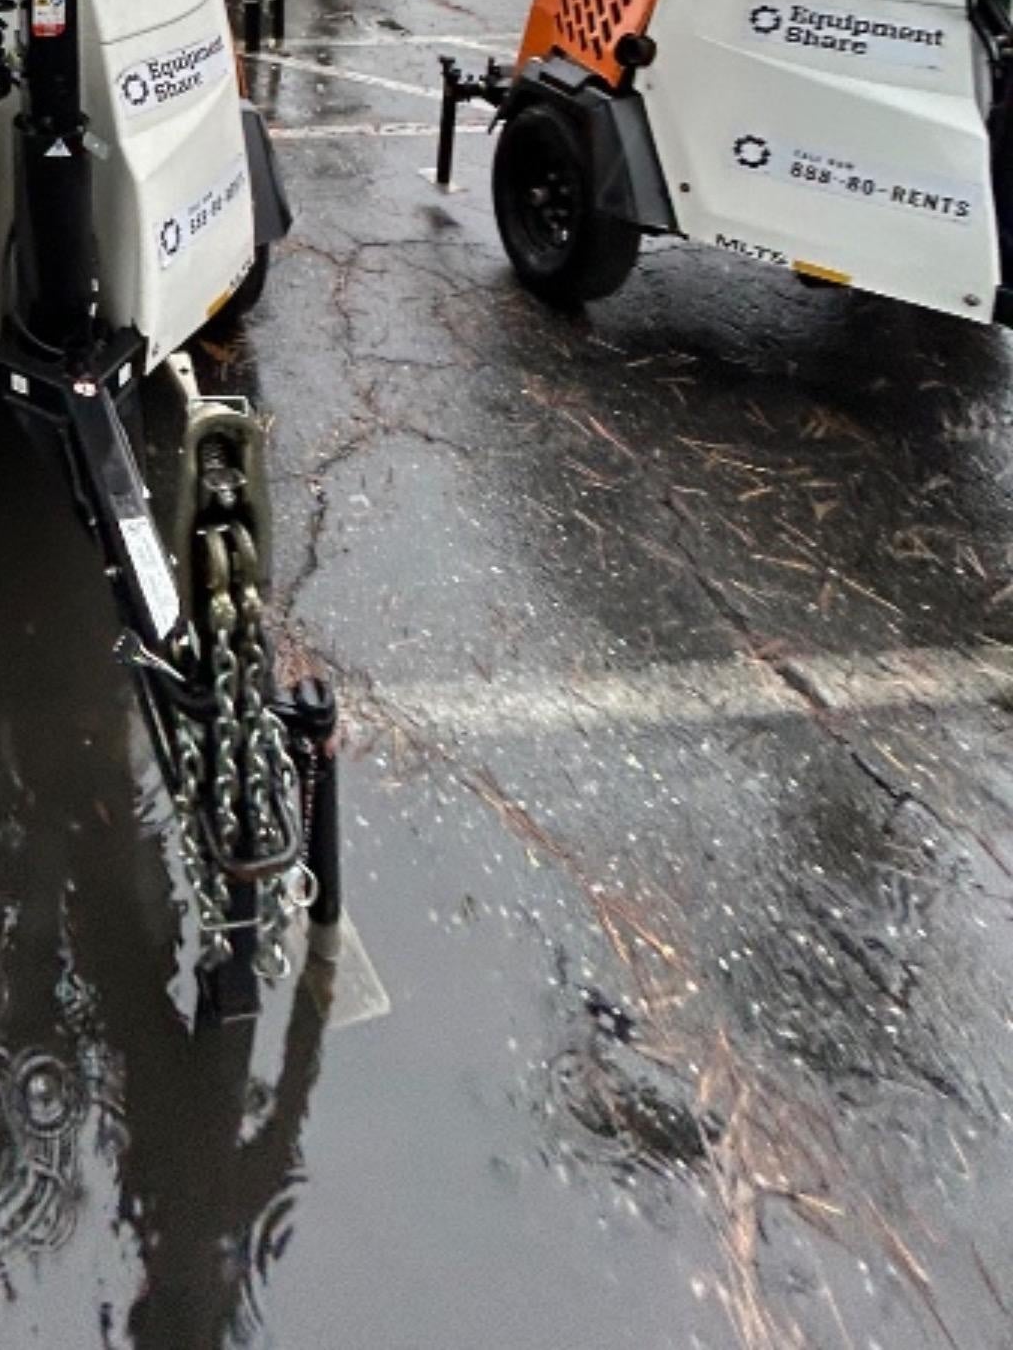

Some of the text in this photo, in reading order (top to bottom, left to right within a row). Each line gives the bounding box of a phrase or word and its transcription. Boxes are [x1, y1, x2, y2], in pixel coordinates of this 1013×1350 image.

[785, 26, 867, 54] Share
[789, 5, 943, 46] Equipment
[791, 161, 970, 217] 888-80-RENTS
